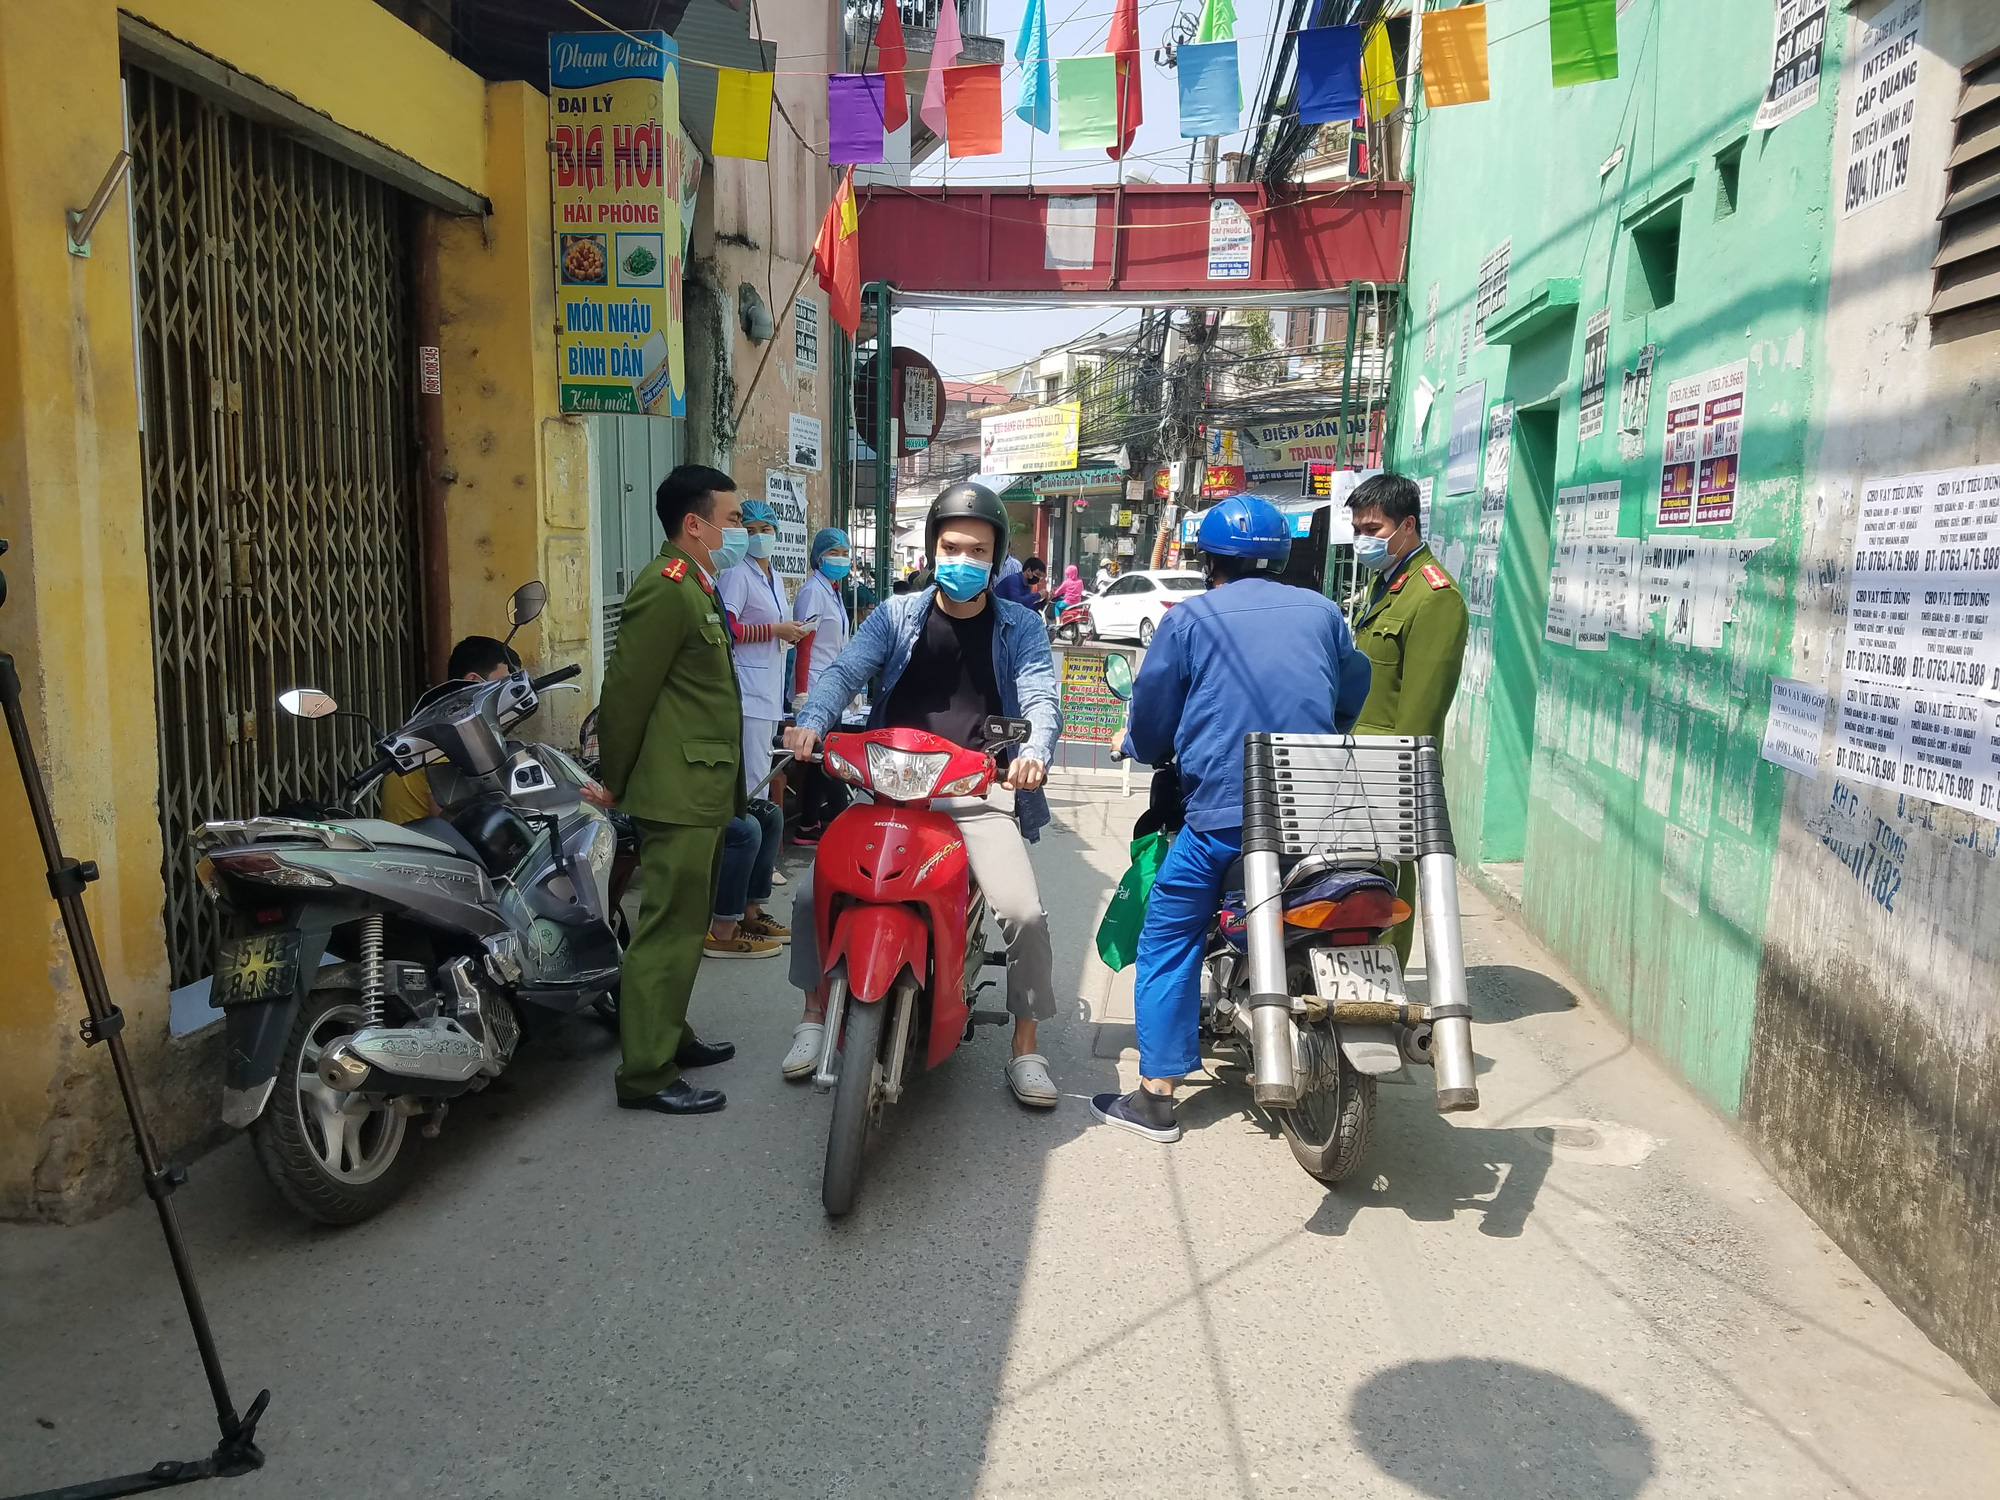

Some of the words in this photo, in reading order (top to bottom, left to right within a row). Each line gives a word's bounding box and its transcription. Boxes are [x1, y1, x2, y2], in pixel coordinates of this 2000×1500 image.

[556, 42, 608, 74] Phạm
[1862, 29, 1918, 83] INTERNET
[1775, 68, 1794, 100] BÌA
[1798, 46, 1817, 85] ĐỎ
[1855, 84, 1877, 118] CÁP
[1879, 60, 1918, 104] QUANG
[557, 97, 587, 116] ĐẠI
[593, 94, 613, 112] LÝ
[1851, 113, 1877, 155] TRUYỀN
[1880, 107, 1901, 139] HÌNH
[1901, 99, 1914, 127] HD
[556, 125, 604, 194] BIA
[613, 118, 664, 194] HƠI
[1845, 134, 1911, 212] 0904.181.799
[564, 196, 592, 223] HẢI
[599, 200, 659, 224] PHÒNG
[567, 297, 603, 332] MÓN
[608, 298, 651, 339] NHẬU
[568, 341, 606, 376] BÌNH
[610, 342, 643, 377] DÂN
[569, 390, 601, 410] Kính
[1262, 424, 1299, 442] ĐIỆN
[1289, 441, 1322, 461] TRẦN
[770, 477, 782, 491] CHO
[1937, 483, 1950, 496] CHO
[1952, 480, 1966, 494] VAY
[1867, 490, 1878, 502] CHO
[1880, 488, 1892, 501] VAY
[784, 533, 794, 544] VAY
[1856, 551, 1867, 571] ĐT:
[1868, 550, 1920, 571] 0763.476.988
[1925, 550, 1938, 571] ĐT:
[1939, 547, 2000, 571] 0763.476.988
[1856, 590, 1867, 603] CHO
[1868, 591, 1880, 604] VAY
[1925, 591, 1937, 605] CHO
[1939, 592, 1951, 606] VAY
[1846, 650, 1857, 670] ĐT:
[1858, 651, 1906, 678] 0763.476.988
[1912, 656, 1925, 679] ĐT:
[1927, 658, 1986, 686] 0763.476.988
[1774, 684, 1787, 697] CHO
[1788, 688, 1801, 701] VAY
[1802, 692, 1811, 706] HỌ
[1811, 694, 1826, 709] GÓP
[1847, 689, 1858, 702] CHO
[1859, 691, 1869, 705] VAY
[1915, 700, 1927, 714] CHO
[1928, 702, 1942, 717] VAY
[1943, 701, 1958, 719] TIÊU
[1958, 703, 1978, 721] DÙNG
[1066, 725, 1088, 733] STAR
[1091, 727, 1113, 735] GOLD
[1911, 719, 1921, 729] THỜI
[1934, 724, 1940, 733] 60
[1954, 727, 1962, 737] 100
[1775, 739, 1818, 766] 0981.868.716
[1912, 736, 1927, 747] KHÔNG
[1937, 741, 1947, 750] CMT
[1837, 748, 1848, 767] ĐT:
[1848, 750, 1896, 782] 0763.476.988
[1917, 750, 1926, 761] THỦ
[1935, 756, 1951, 767] NHANH
[1903, 764, 1915, 786] ĐT:
[1916, 767, 1974, 801] 0763.476.988
[873, 821, 909, 830] HONDA
